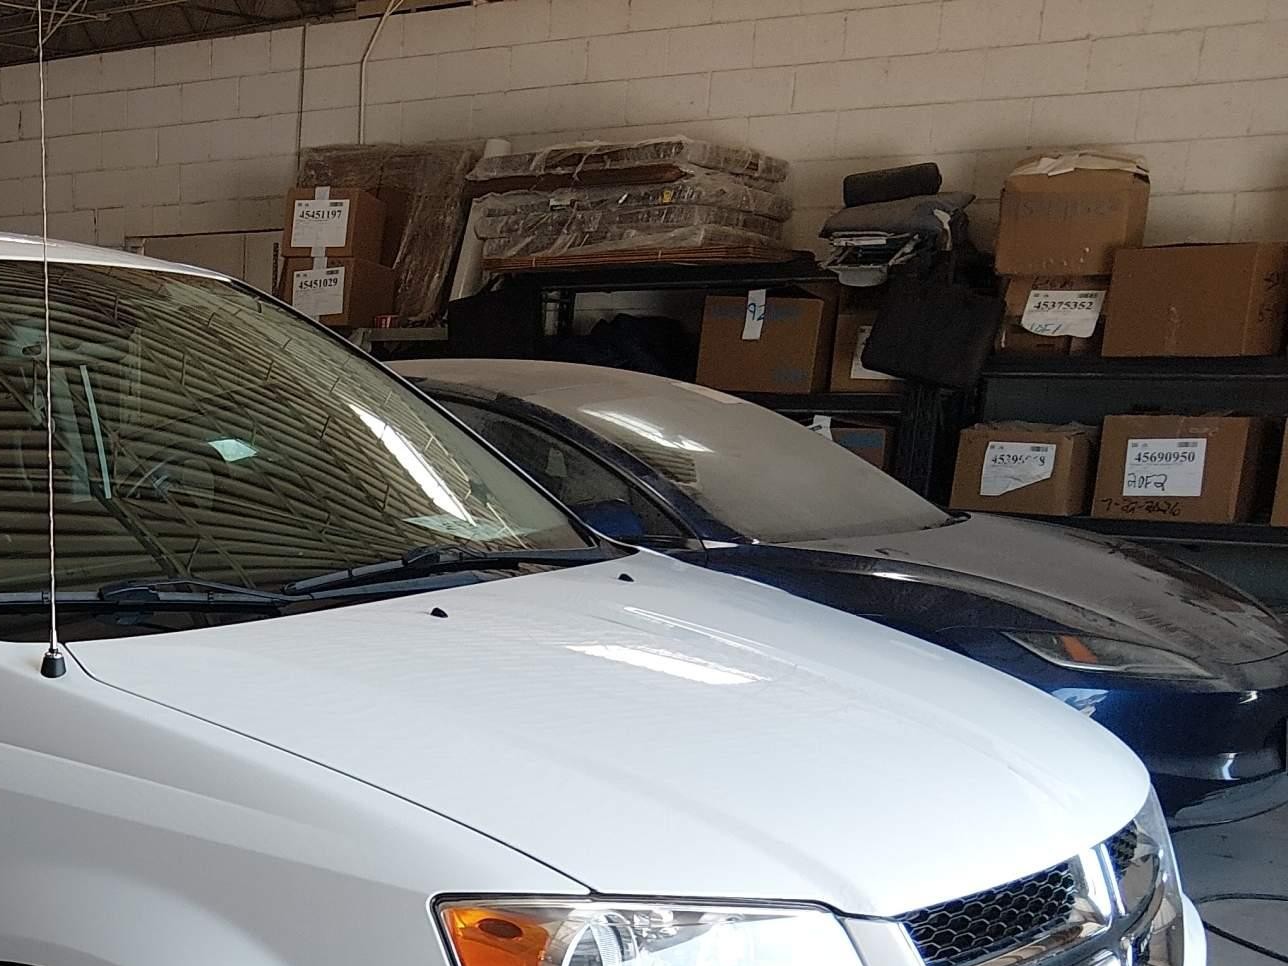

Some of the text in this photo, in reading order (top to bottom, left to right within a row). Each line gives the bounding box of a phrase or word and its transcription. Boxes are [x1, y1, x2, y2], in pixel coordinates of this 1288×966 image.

[299, 209, 342, 220] 45451197
[298, 277, 338, 290] 45451029
[1033, 301, 1094, 311] 45375352
[1134, 451, 1196, 463] 45690950
